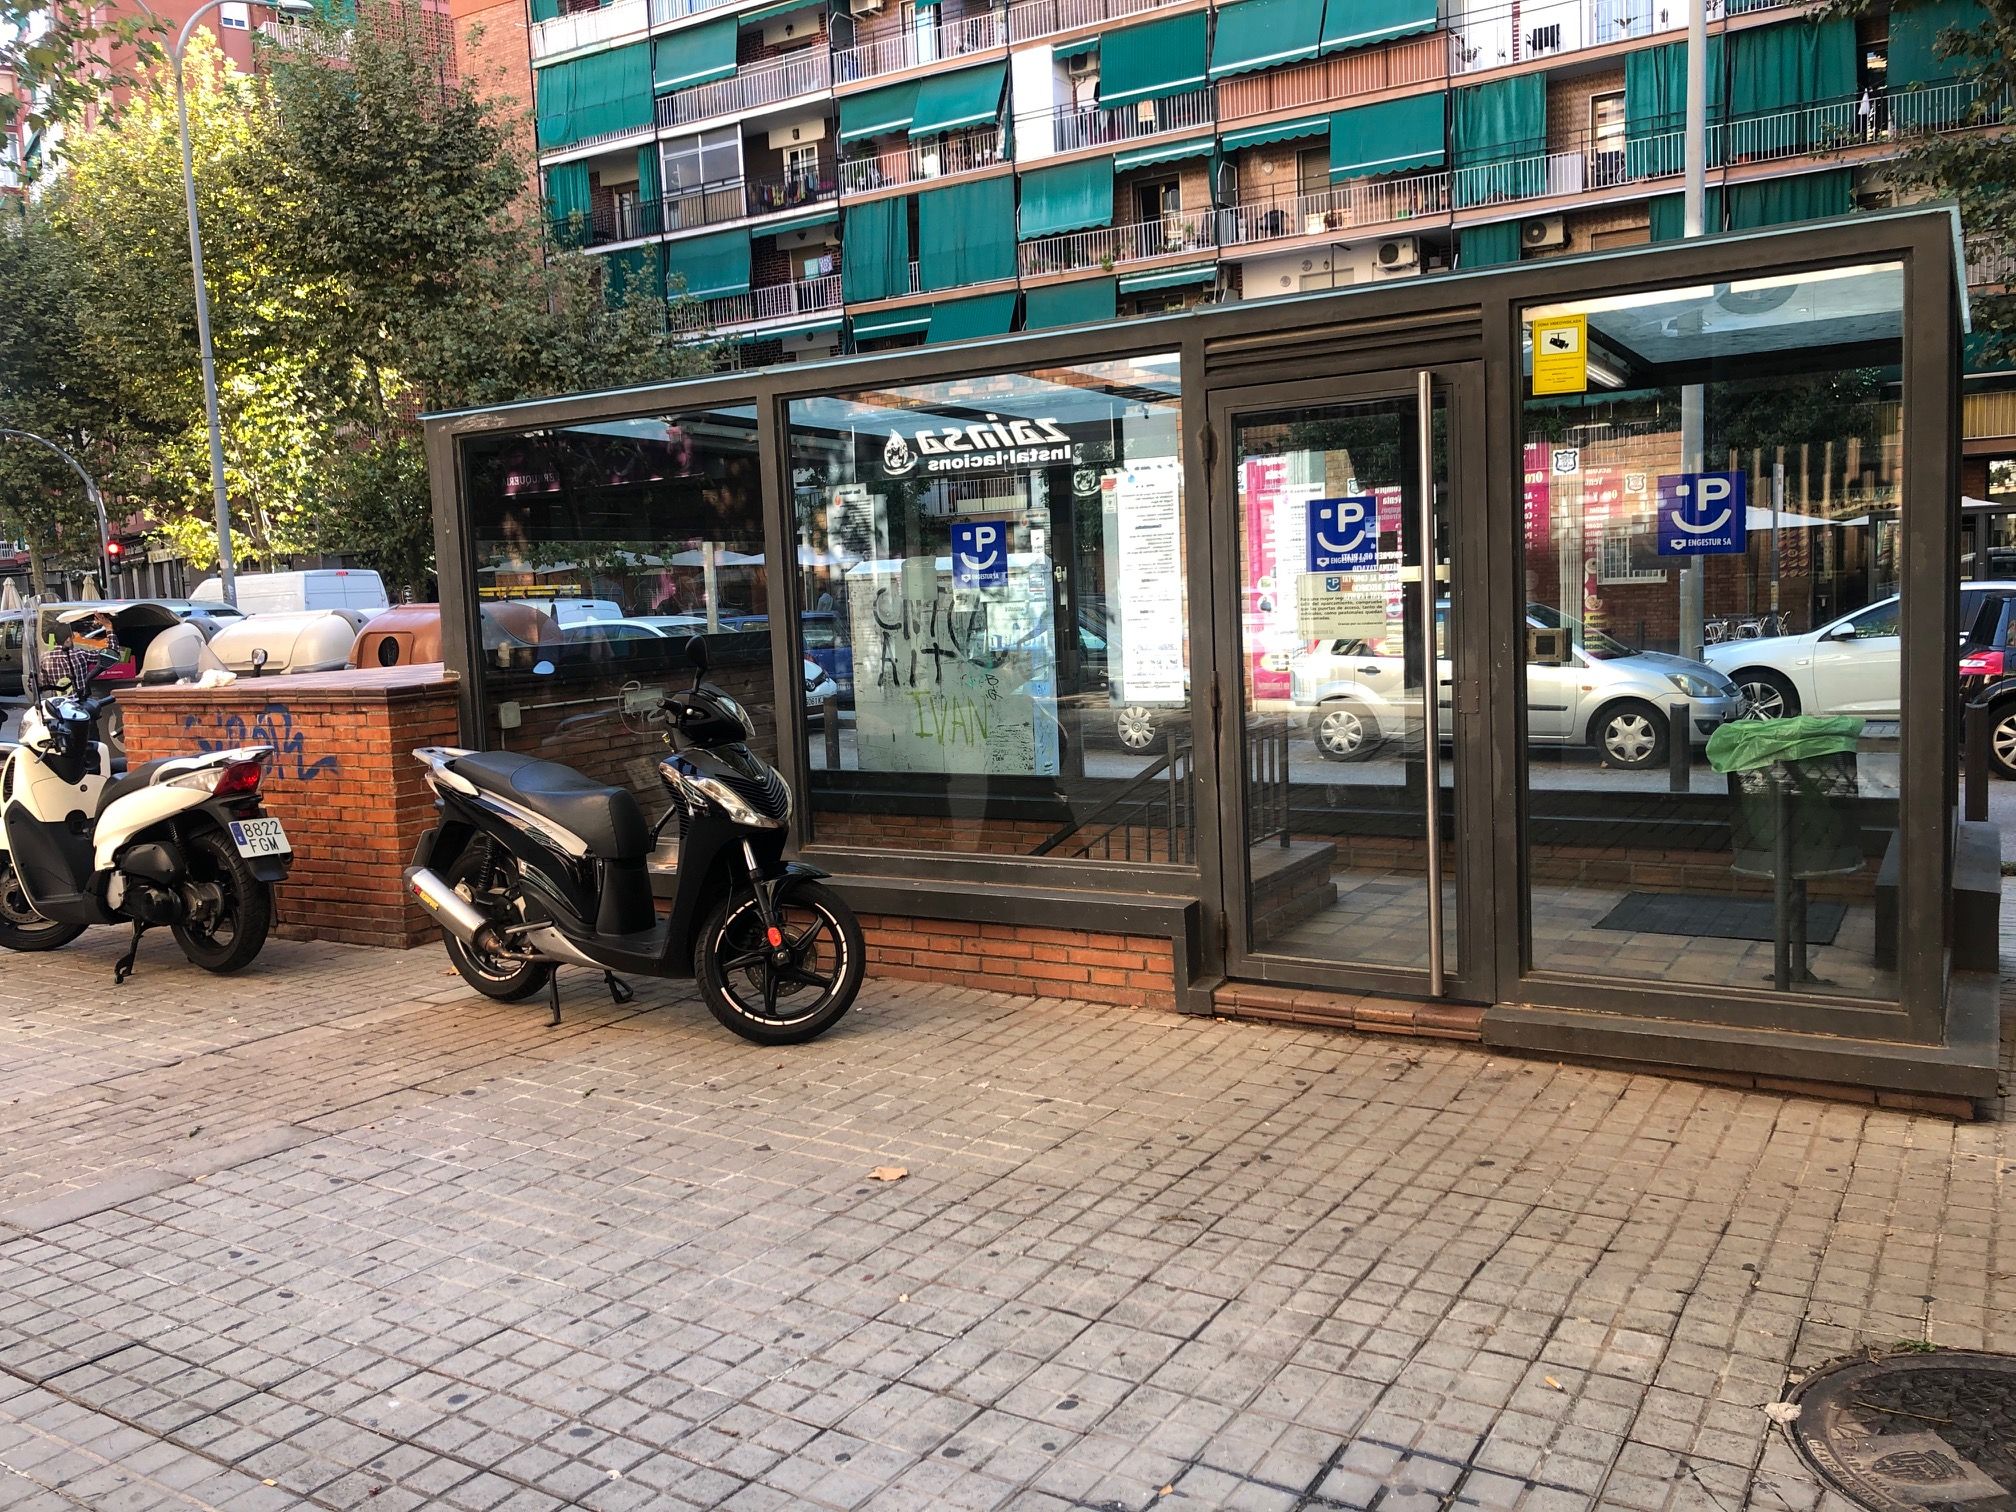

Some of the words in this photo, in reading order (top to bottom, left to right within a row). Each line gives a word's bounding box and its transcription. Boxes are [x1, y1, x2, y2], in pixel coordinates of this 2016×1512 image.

[1687, 537, 1722, 547] ENGESTUR
[1722, 537, 1732, 546] SA
[905, 691, 988, 748] IVAN
[243, 820, 282, 838] 8822
[249, 836, 280, 853] FGM
